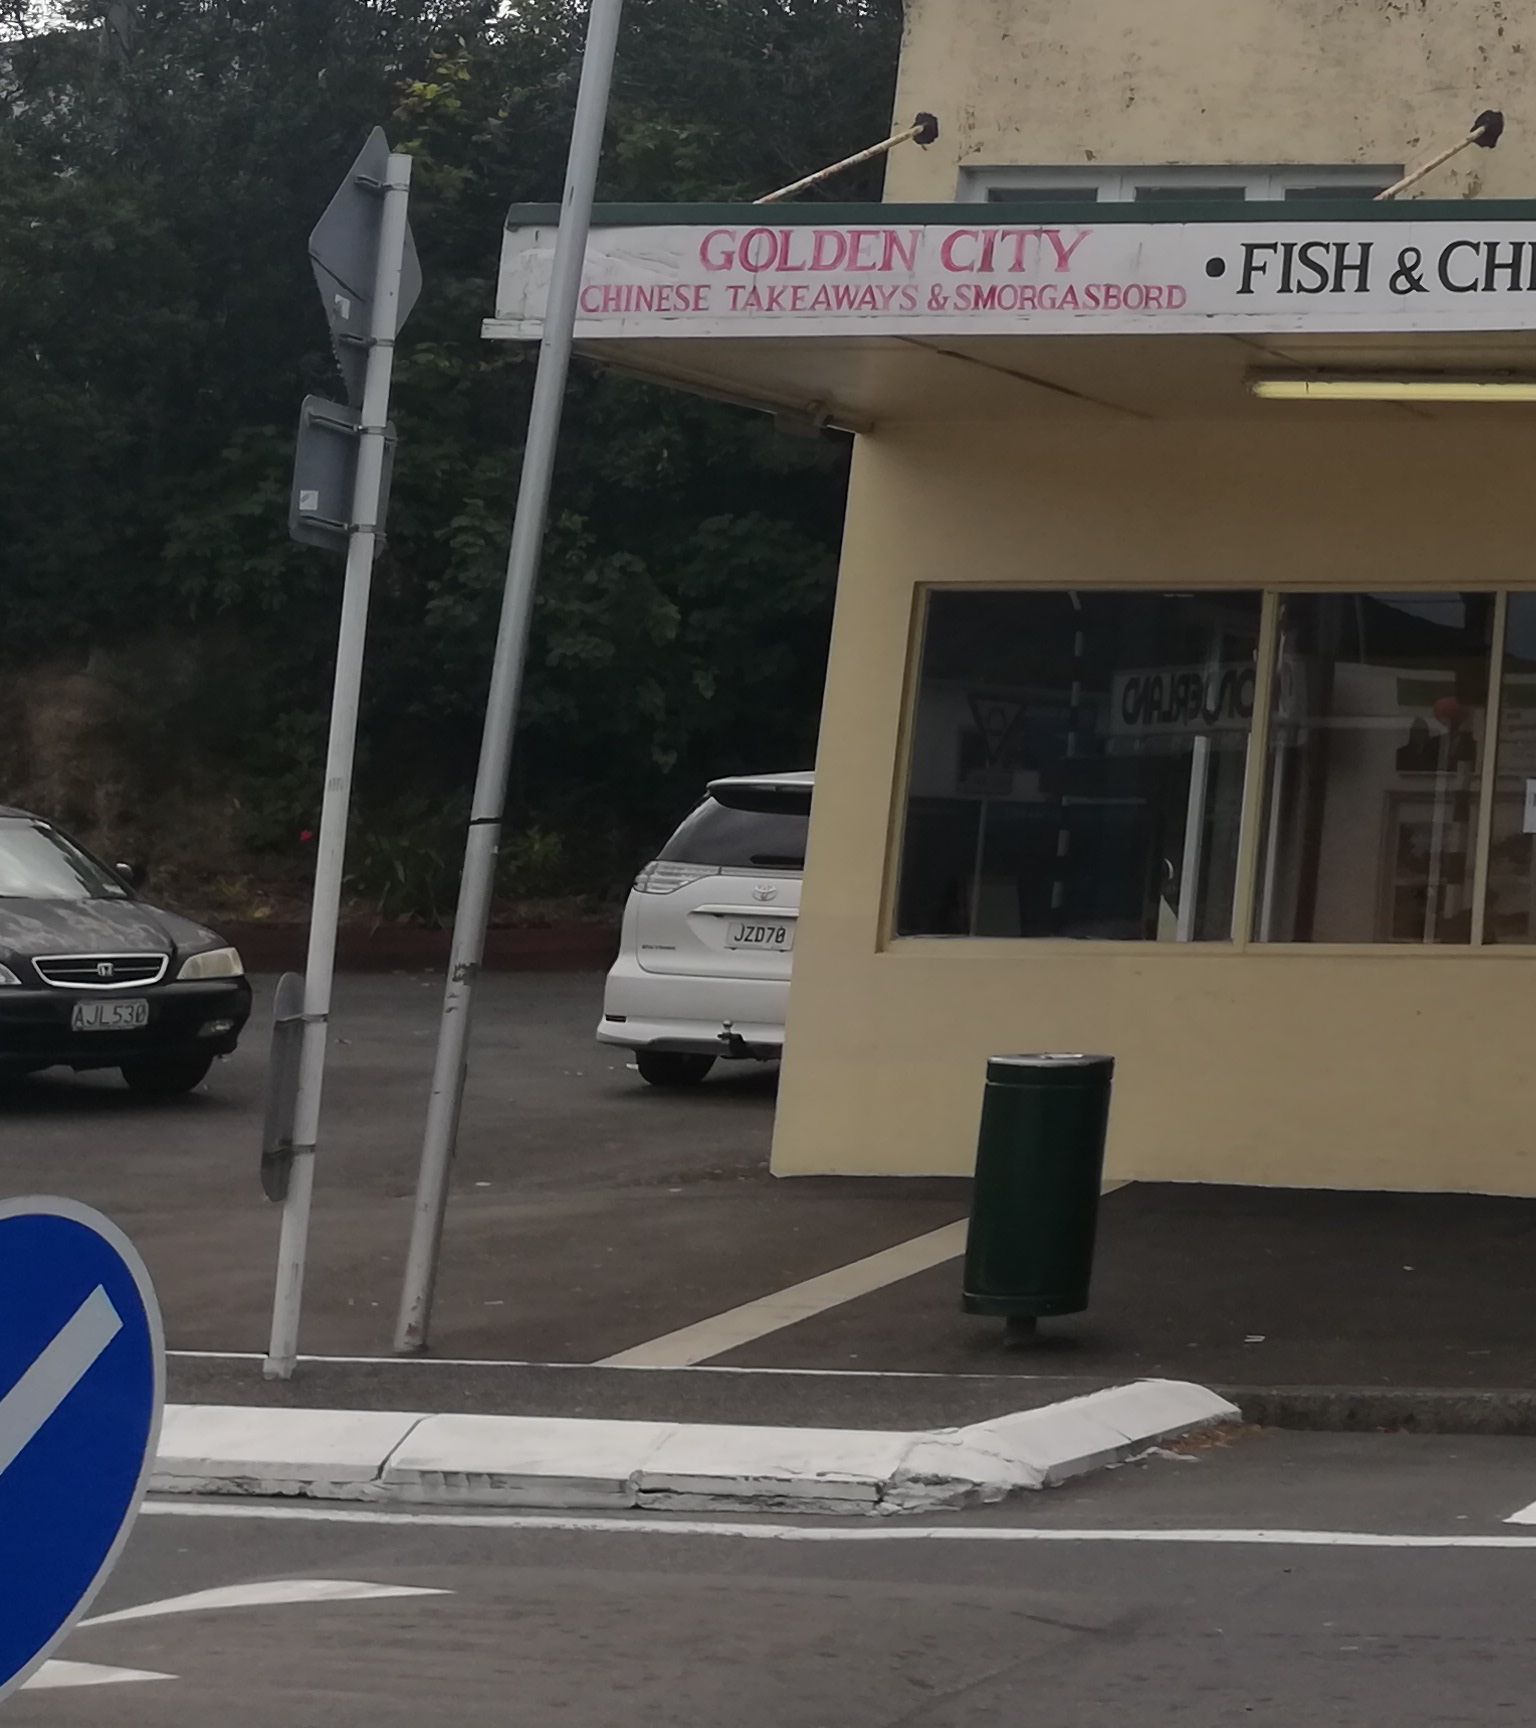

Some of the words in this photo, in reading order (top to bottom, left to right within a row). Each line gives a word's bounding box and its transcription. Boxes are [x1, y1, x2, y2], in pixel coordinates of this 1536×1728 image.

[700, 228, 919, 273] GOLDEN
[939, 227, 1093, 273] CITY
[1236, 240, 1374, 295] FISH
[1389, 245, 1427, 294] &
[580, 283, 710, 313] CHINESE
[728, 282, 918, 311] TAKEAWAYS
[954, 282, 1187, 311] SMORGASBORD
[734, 924, 786, 944] JZD70
[74, 1004, 147, 1026] AJL530
